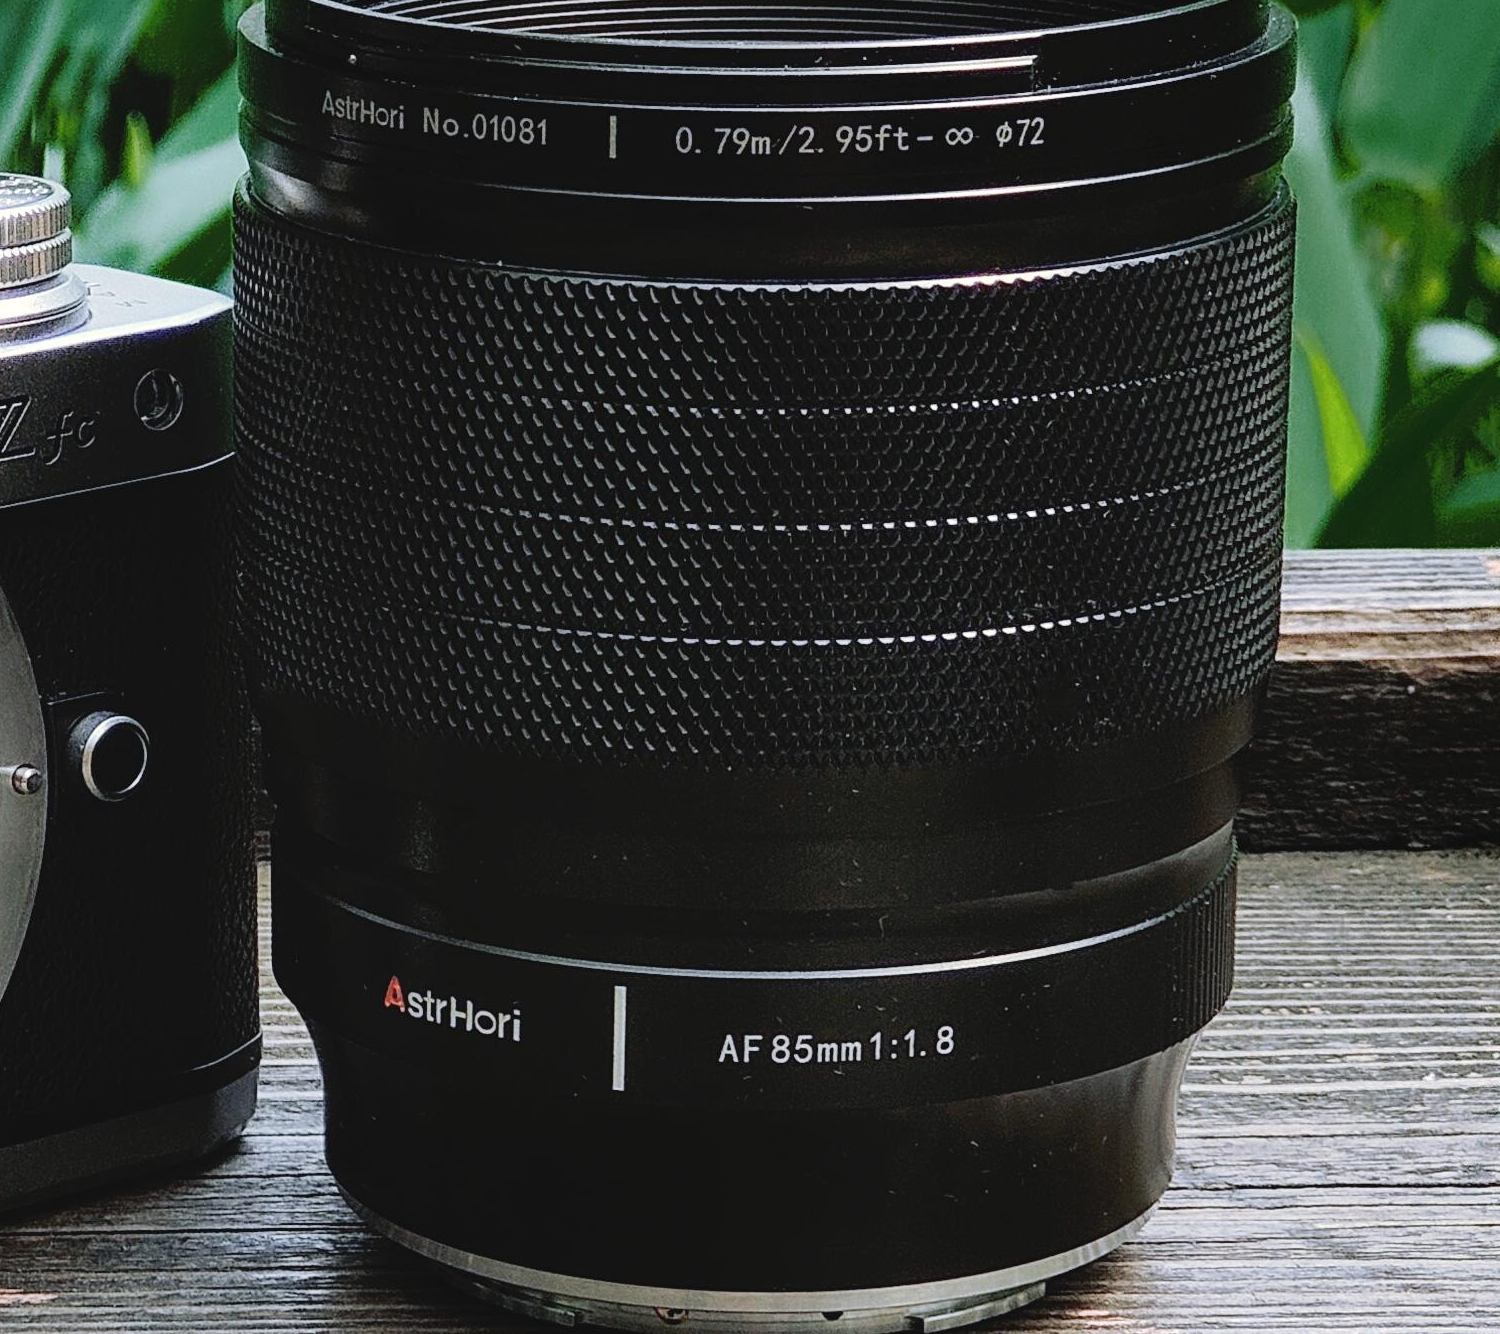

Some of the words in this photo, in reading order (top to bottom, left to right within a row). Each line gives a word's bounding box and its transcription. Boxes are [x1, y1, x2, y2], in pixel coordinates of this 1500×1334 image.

[322, 90, 405, 130] AstrHori
[423, 107, 548, 146] No.01081
[384, 975, 521, 1042] AstrHori
[718, 1034, 762, 1063] AF
